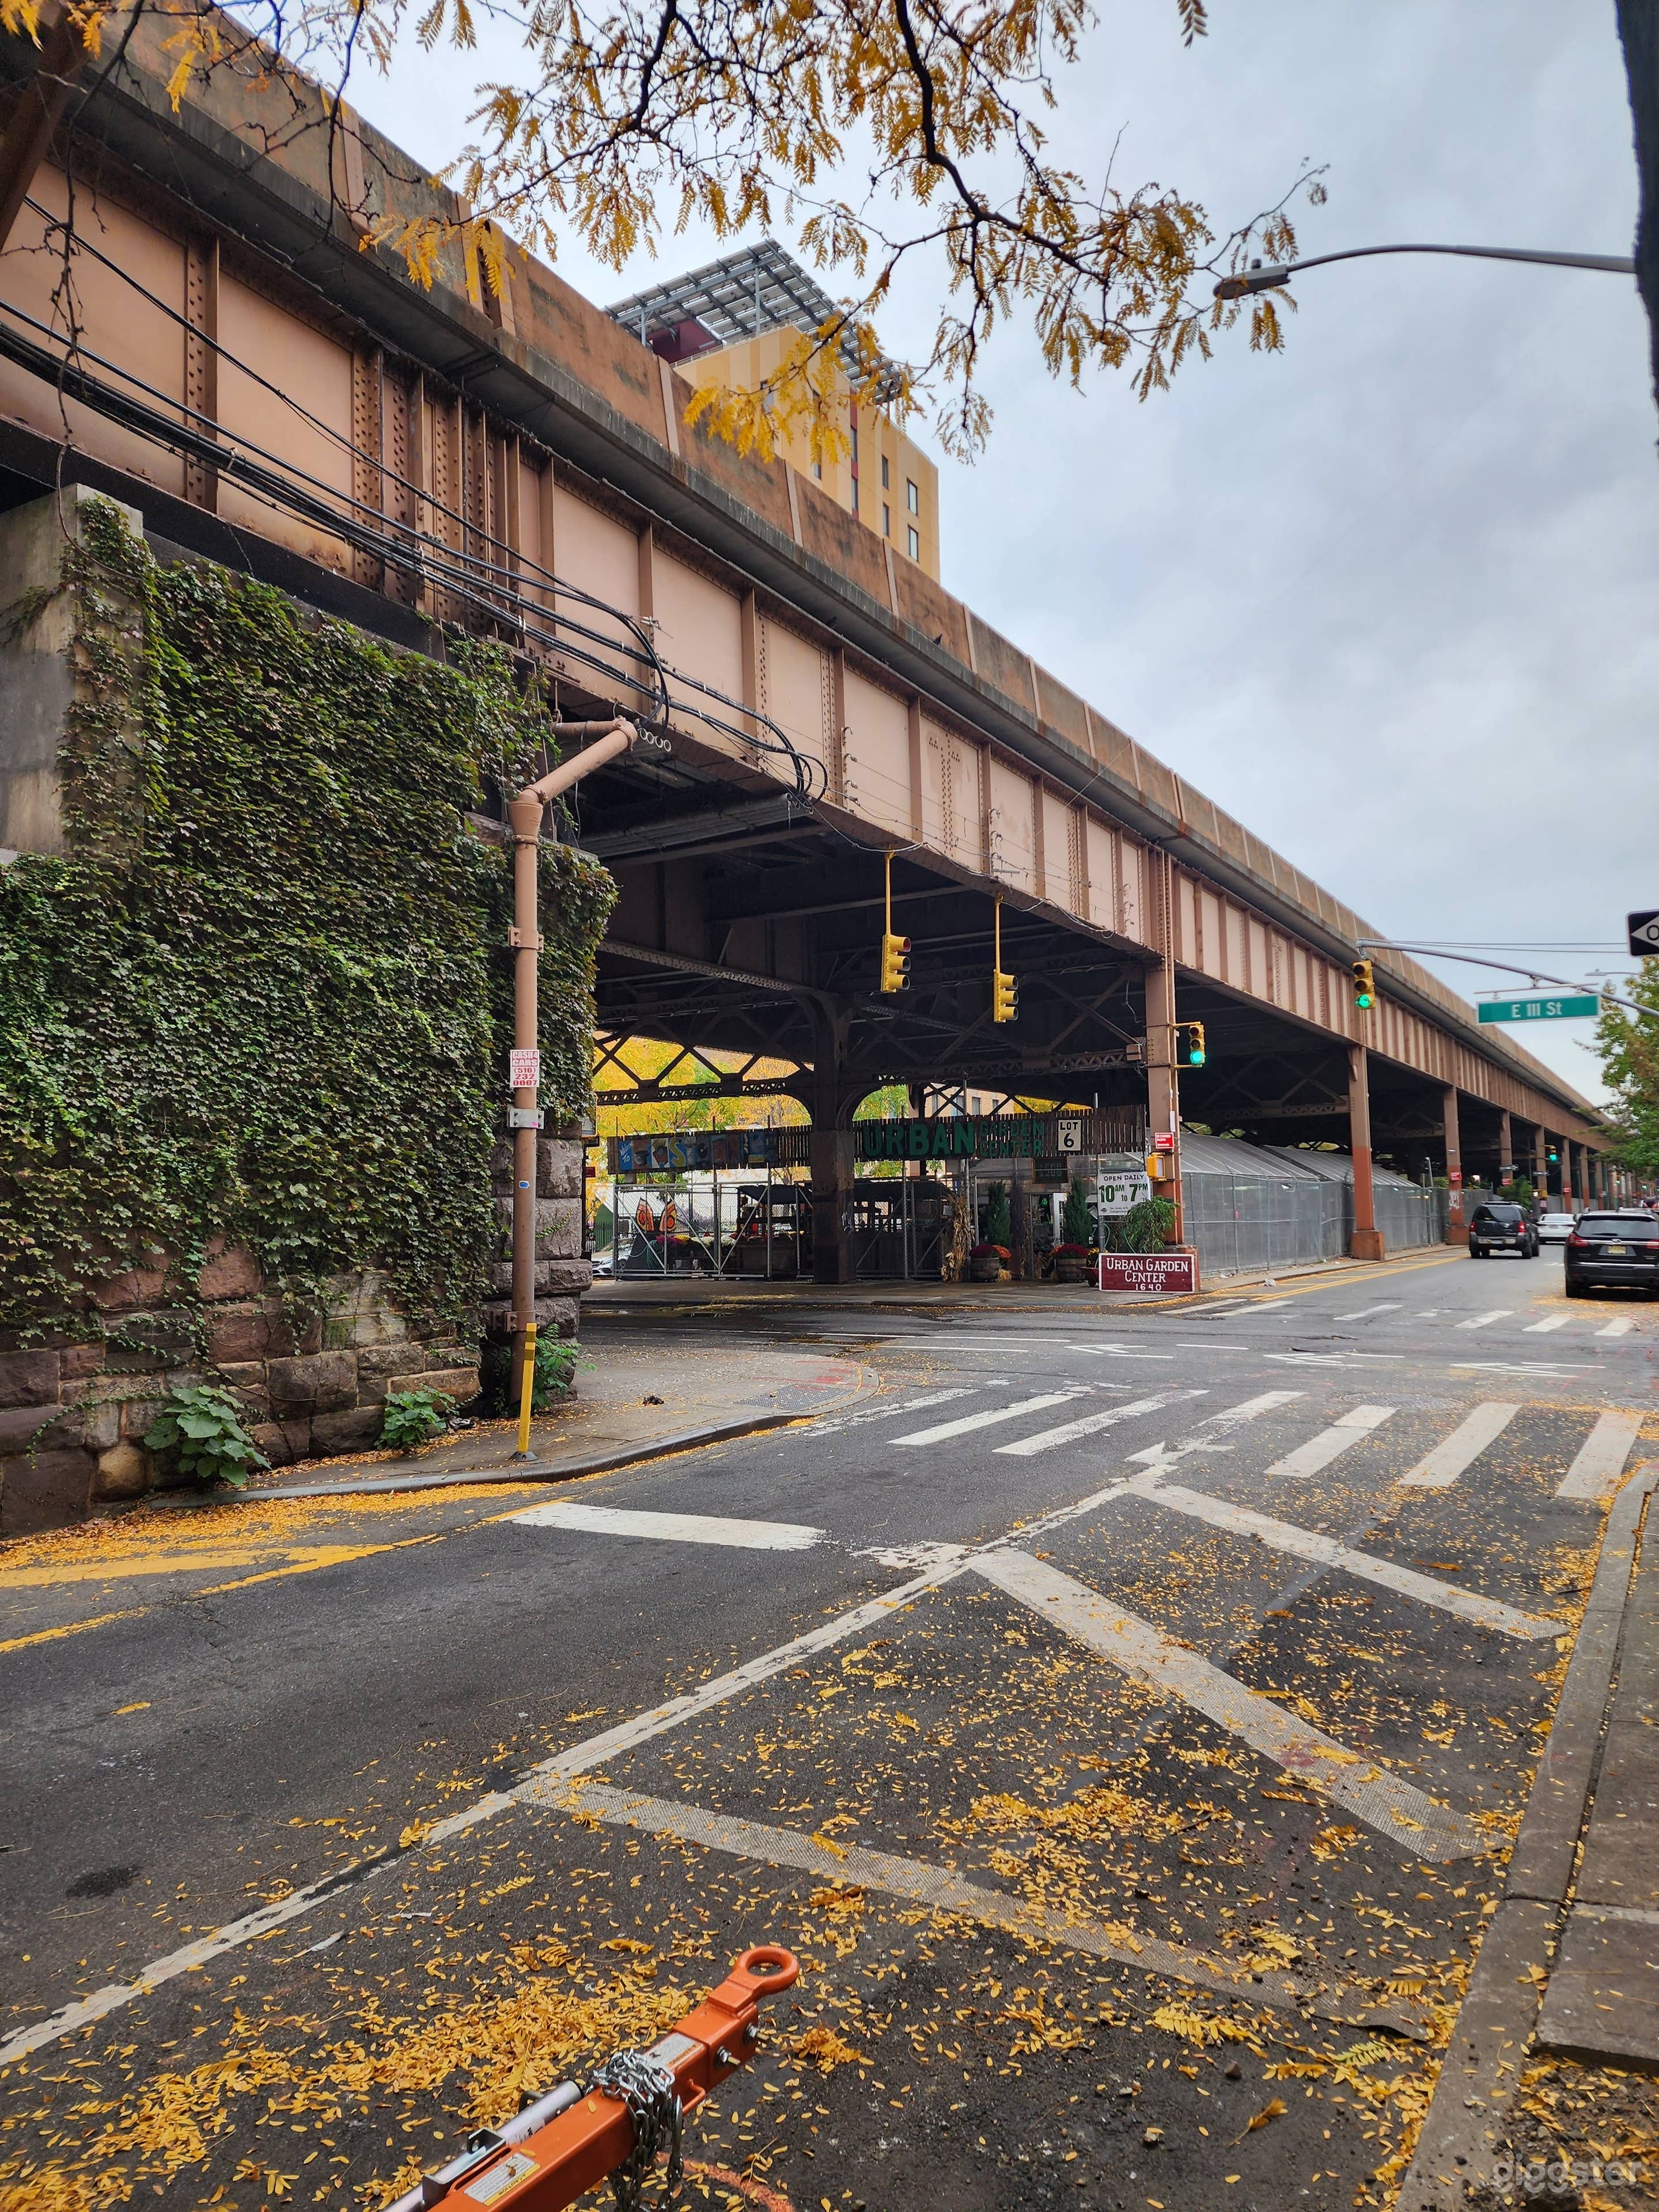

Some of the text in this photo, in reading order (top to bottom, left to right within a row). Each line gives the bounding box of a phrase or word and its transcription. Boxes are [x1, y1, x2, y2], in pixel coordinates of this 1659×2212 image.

[1512, 1001, 1562, 1018] E 111 St
[979, 1119, 1044, 1138] GARDEN
[1060, 1122, 1078, 1130] LOT
[862, 1121, 975, 1157] URBAN
[1064, 1132, 1074, 1148] 6
[979, 1138, 1044, 1158] CENTER
[1107, 1257, 1189, 1272] URBAN GARDEN
[1125, 1270, 1166, 1283] CENTER
[1135, 1283, 1162, 1291] 1640
